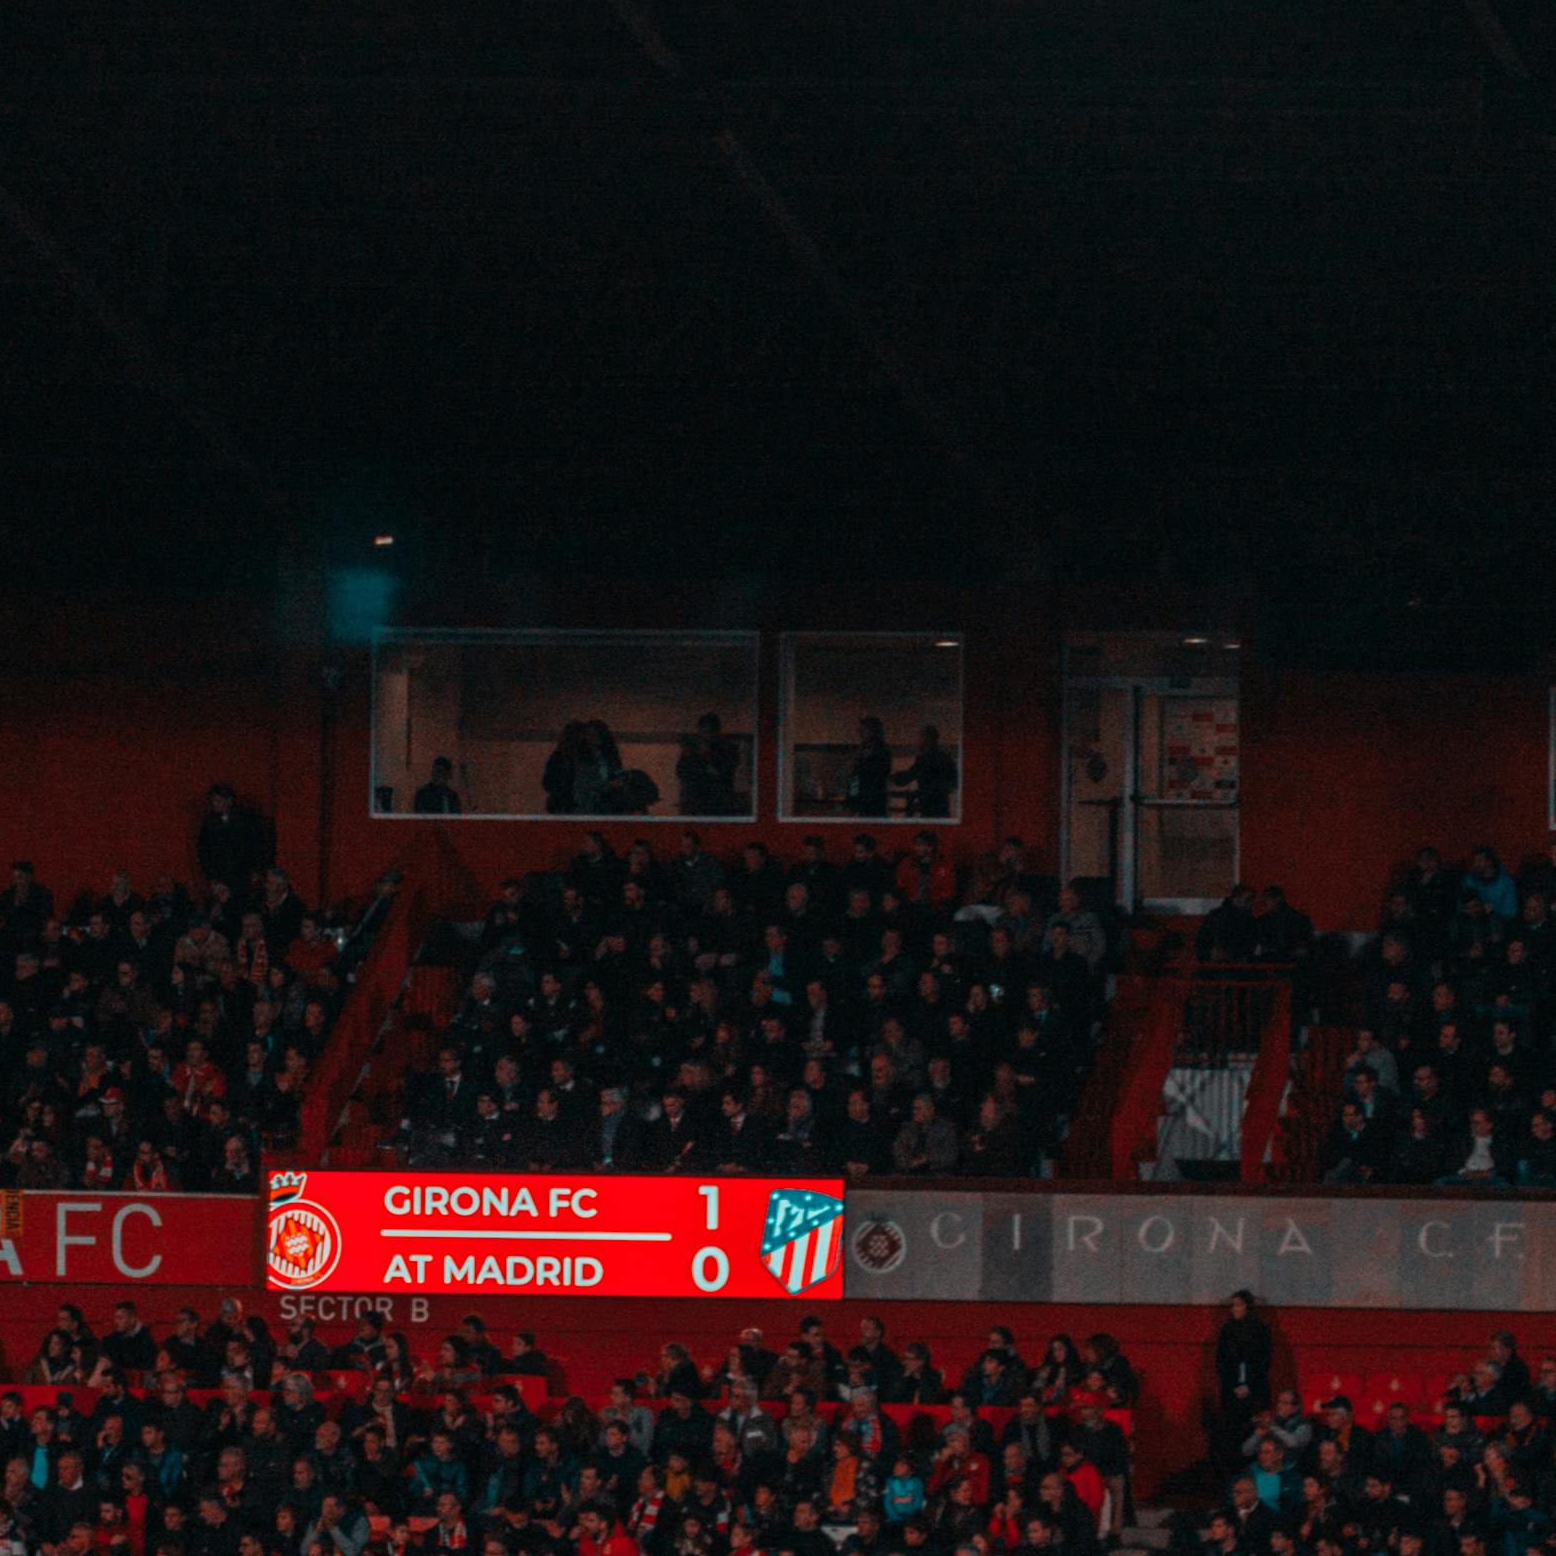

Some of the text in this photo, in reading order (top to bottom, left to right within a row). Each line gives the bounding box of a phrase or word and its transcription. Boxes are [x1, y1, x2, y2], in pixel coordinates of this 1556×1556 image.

[383, 1184, 599, 1219] GIRONA FC
[697, 1184, 721, 1231] 1
[55, 1201, 164, 1279] FC
[382, 1252, 605, 1288] AT MADRID
[690, 1245, 731, 1293] 0
[279, 1294, 430, 1323] SECTOR B
